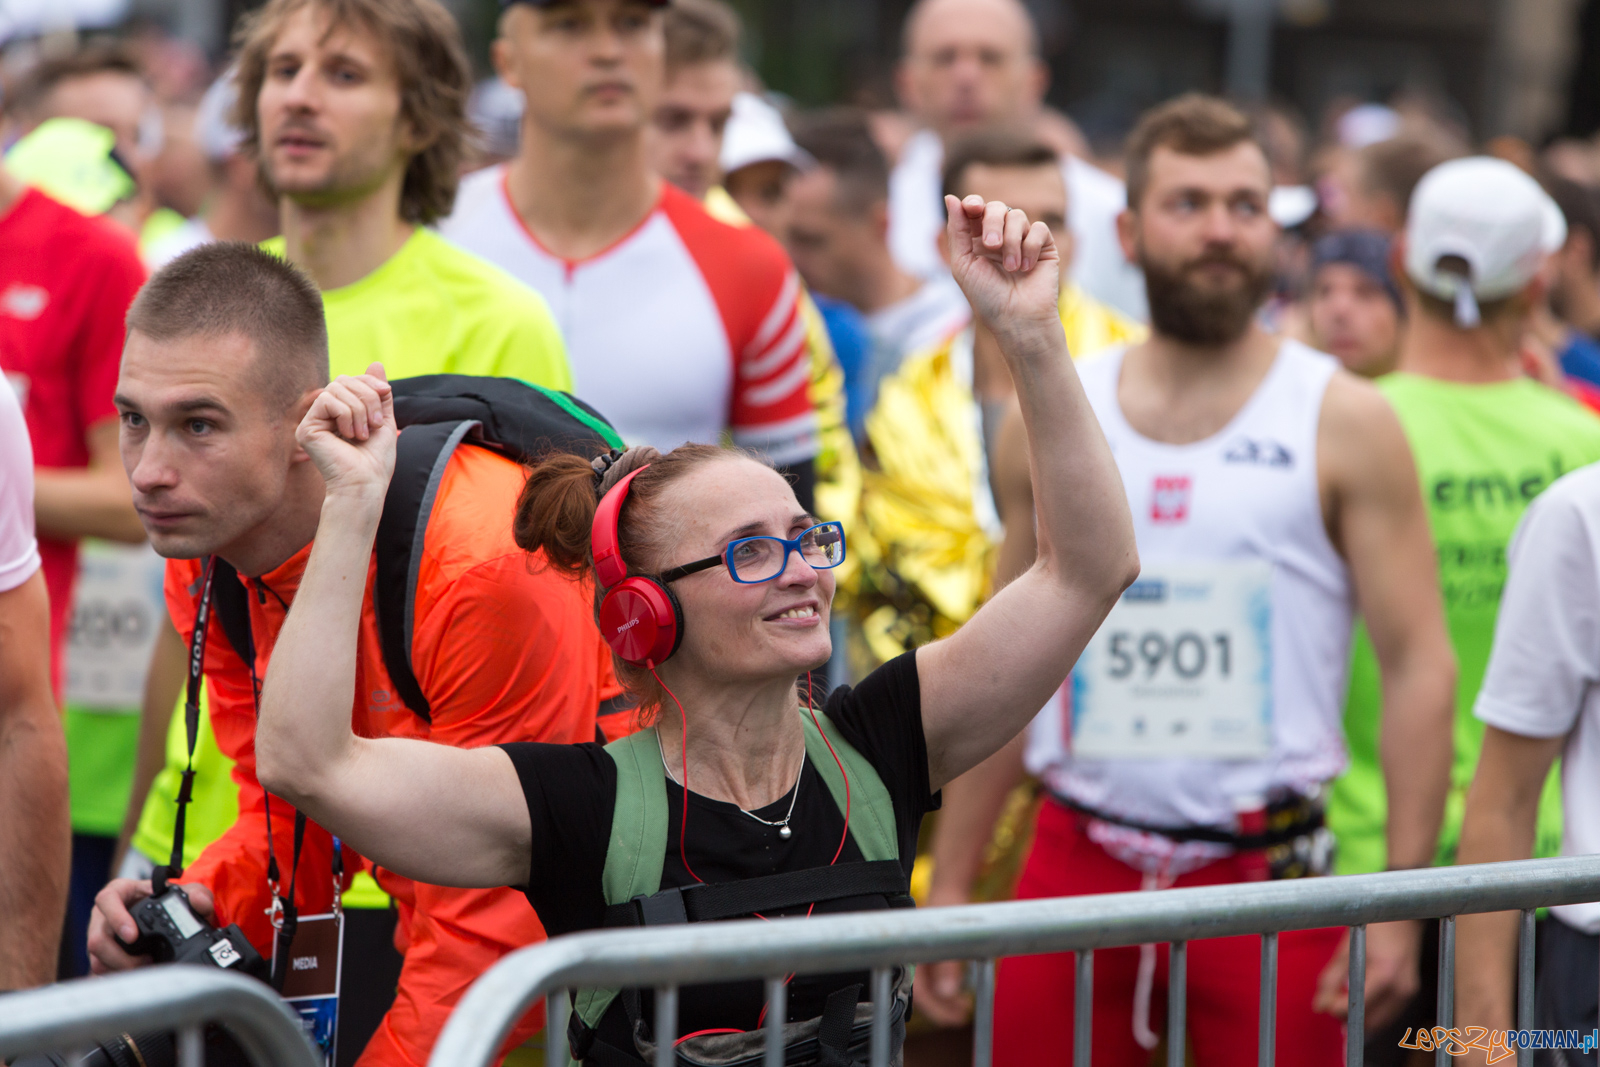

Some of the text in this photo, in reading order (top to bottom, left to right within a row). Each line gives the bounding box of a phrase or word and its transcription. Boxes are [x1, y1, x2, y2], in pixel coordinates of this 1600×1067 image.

[617, 618, 640, 634] PHILIPS
[1107, 630, 1233, 681] 5901
[293, 956, 318, 970] MEDIA
